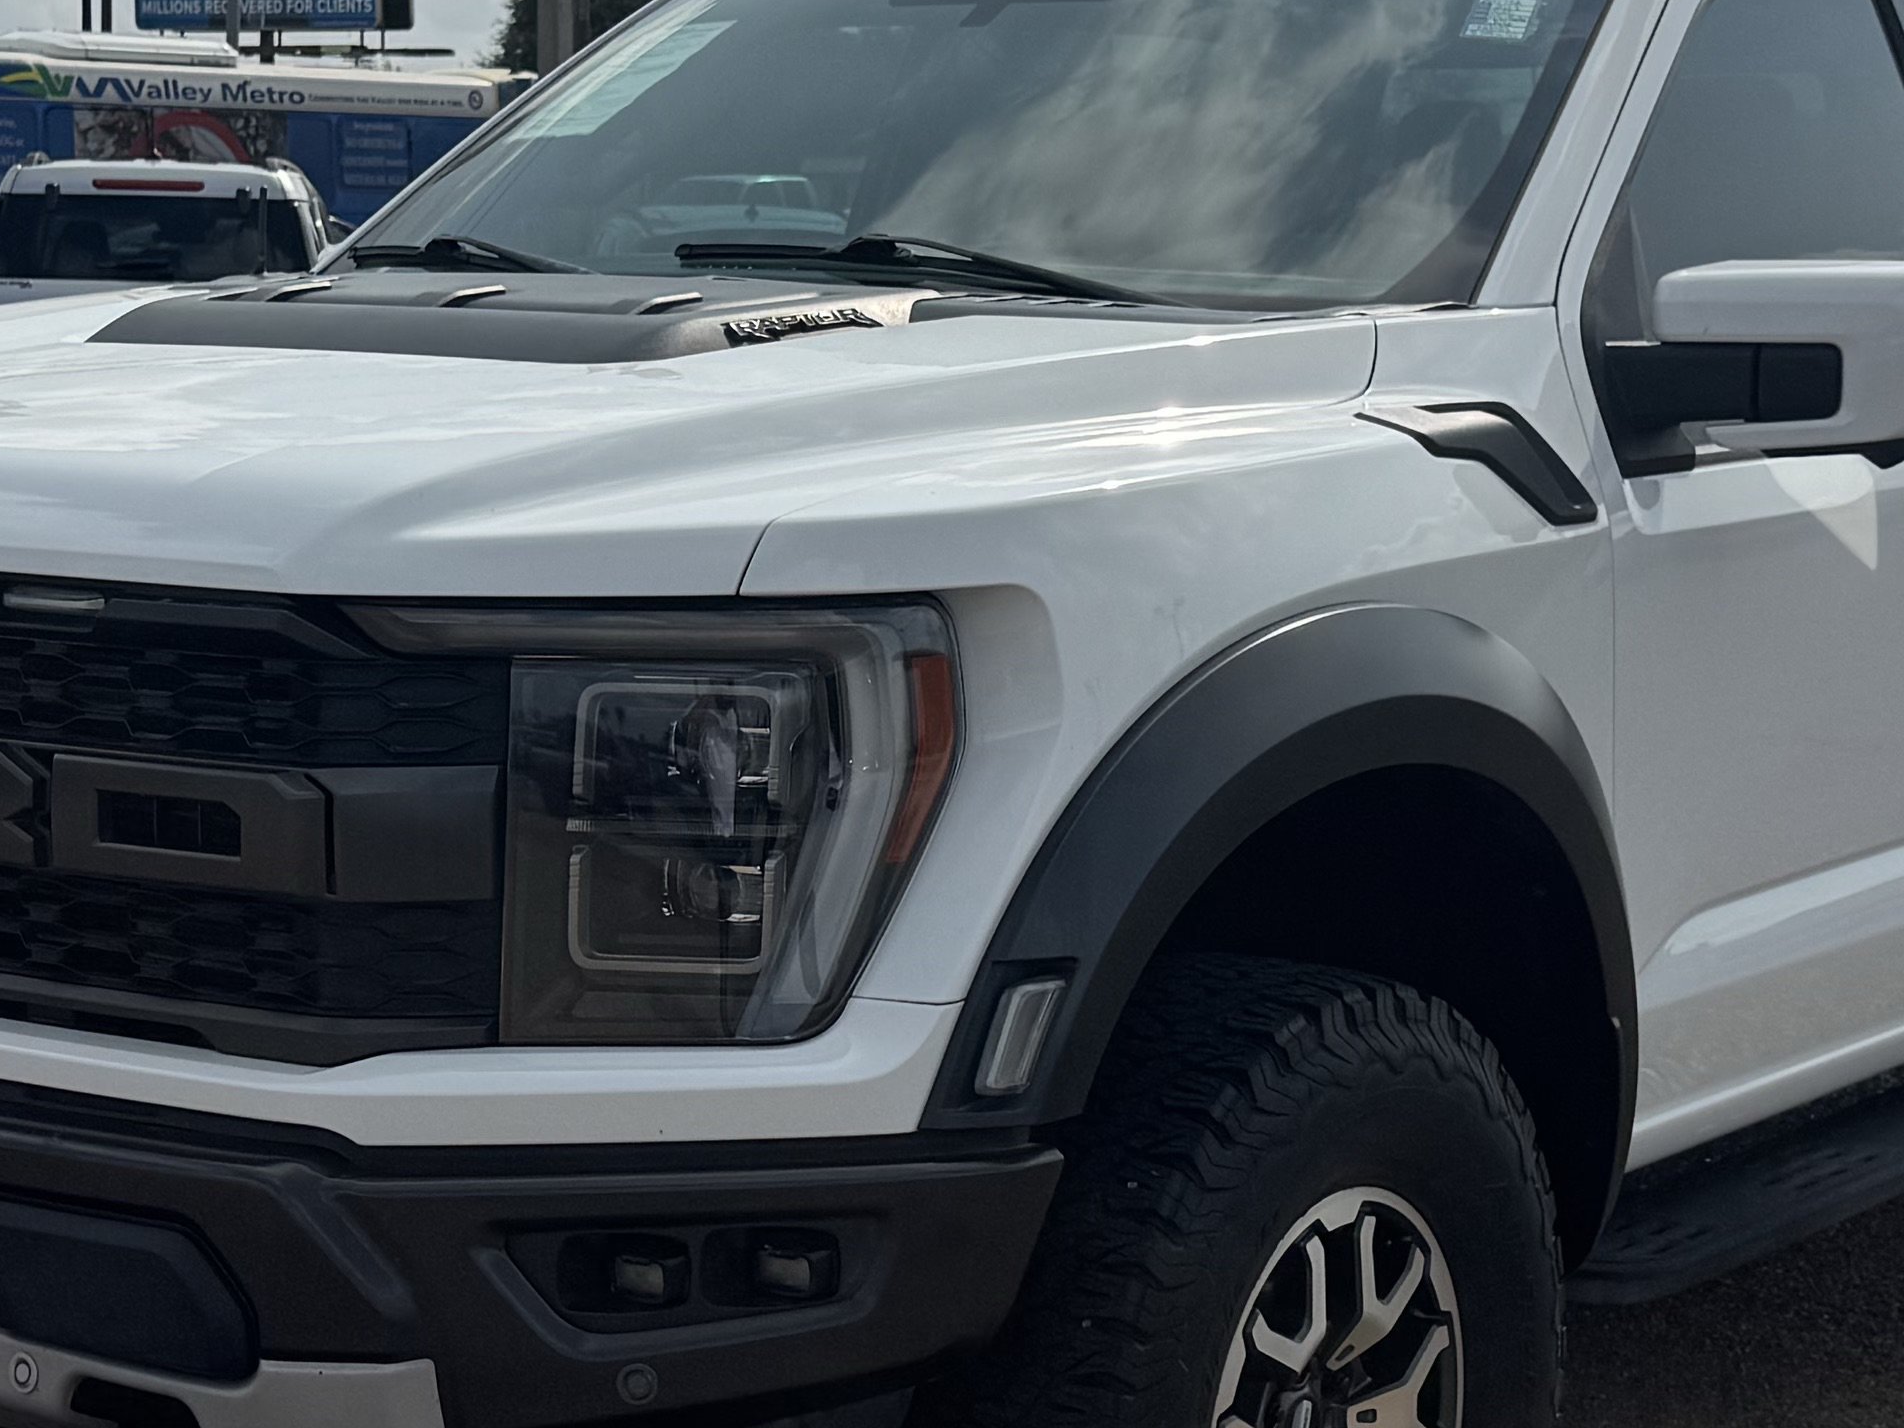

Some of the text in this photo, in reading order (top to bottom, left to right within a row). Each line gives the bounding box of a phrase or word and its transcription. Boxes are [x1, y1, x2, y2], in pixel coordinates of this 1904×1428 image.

[141, 0, 201, 15] MILLIONS
[124, 79, 305, 105] Valley Metro
[724, 308, 882, 342] RAPTOR
